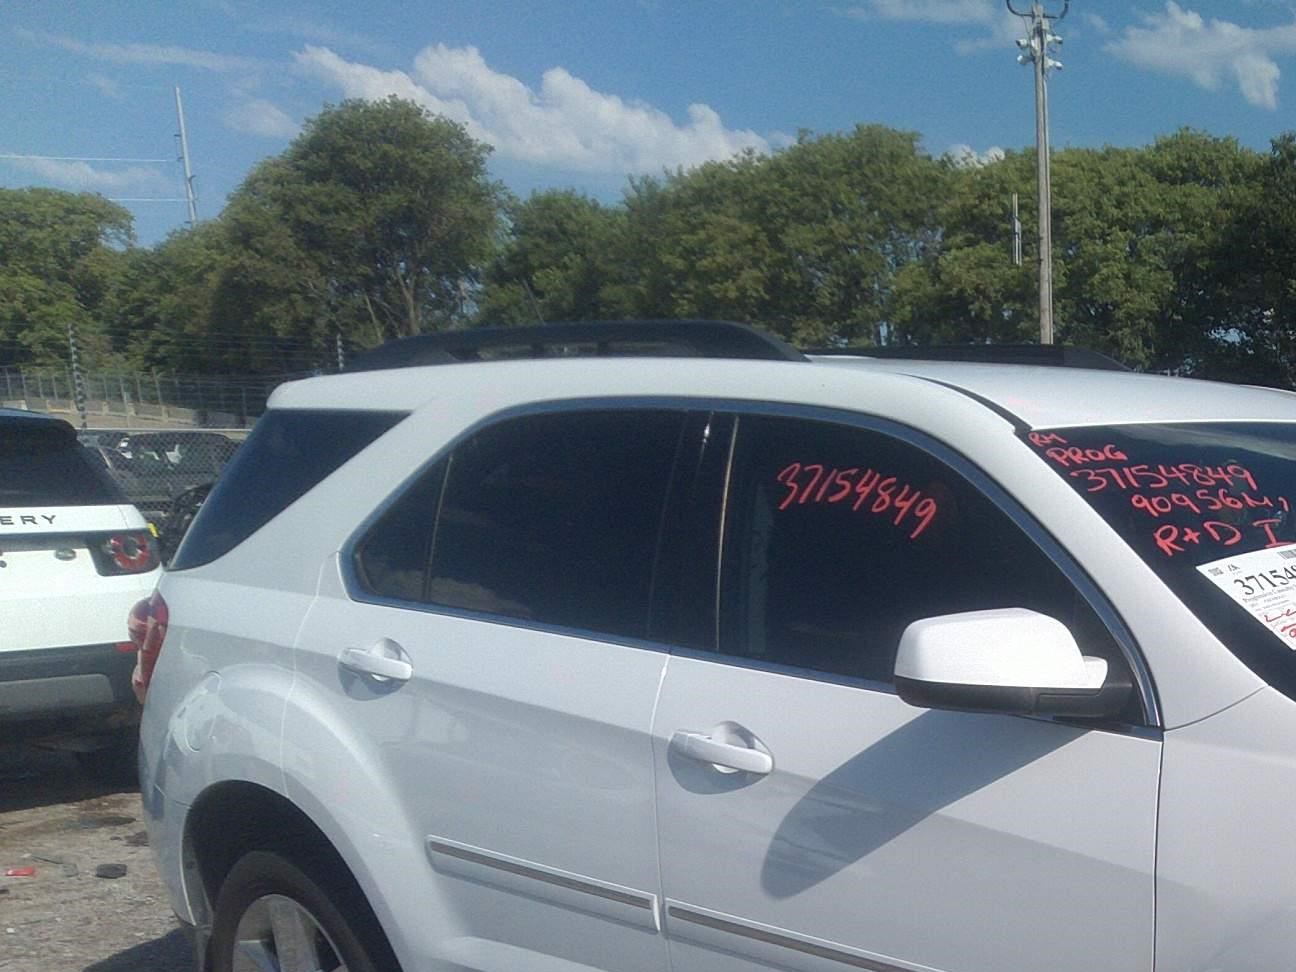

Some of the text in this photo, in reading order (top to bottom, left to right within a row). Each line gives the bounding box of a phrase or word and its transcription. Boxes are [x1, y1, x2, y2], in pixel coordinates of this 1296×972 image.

[1046, 444, 1128, 466] PROG
[1070, 463, 1257, 491] 37154849
[777, 463, 937, 539] 37154849
